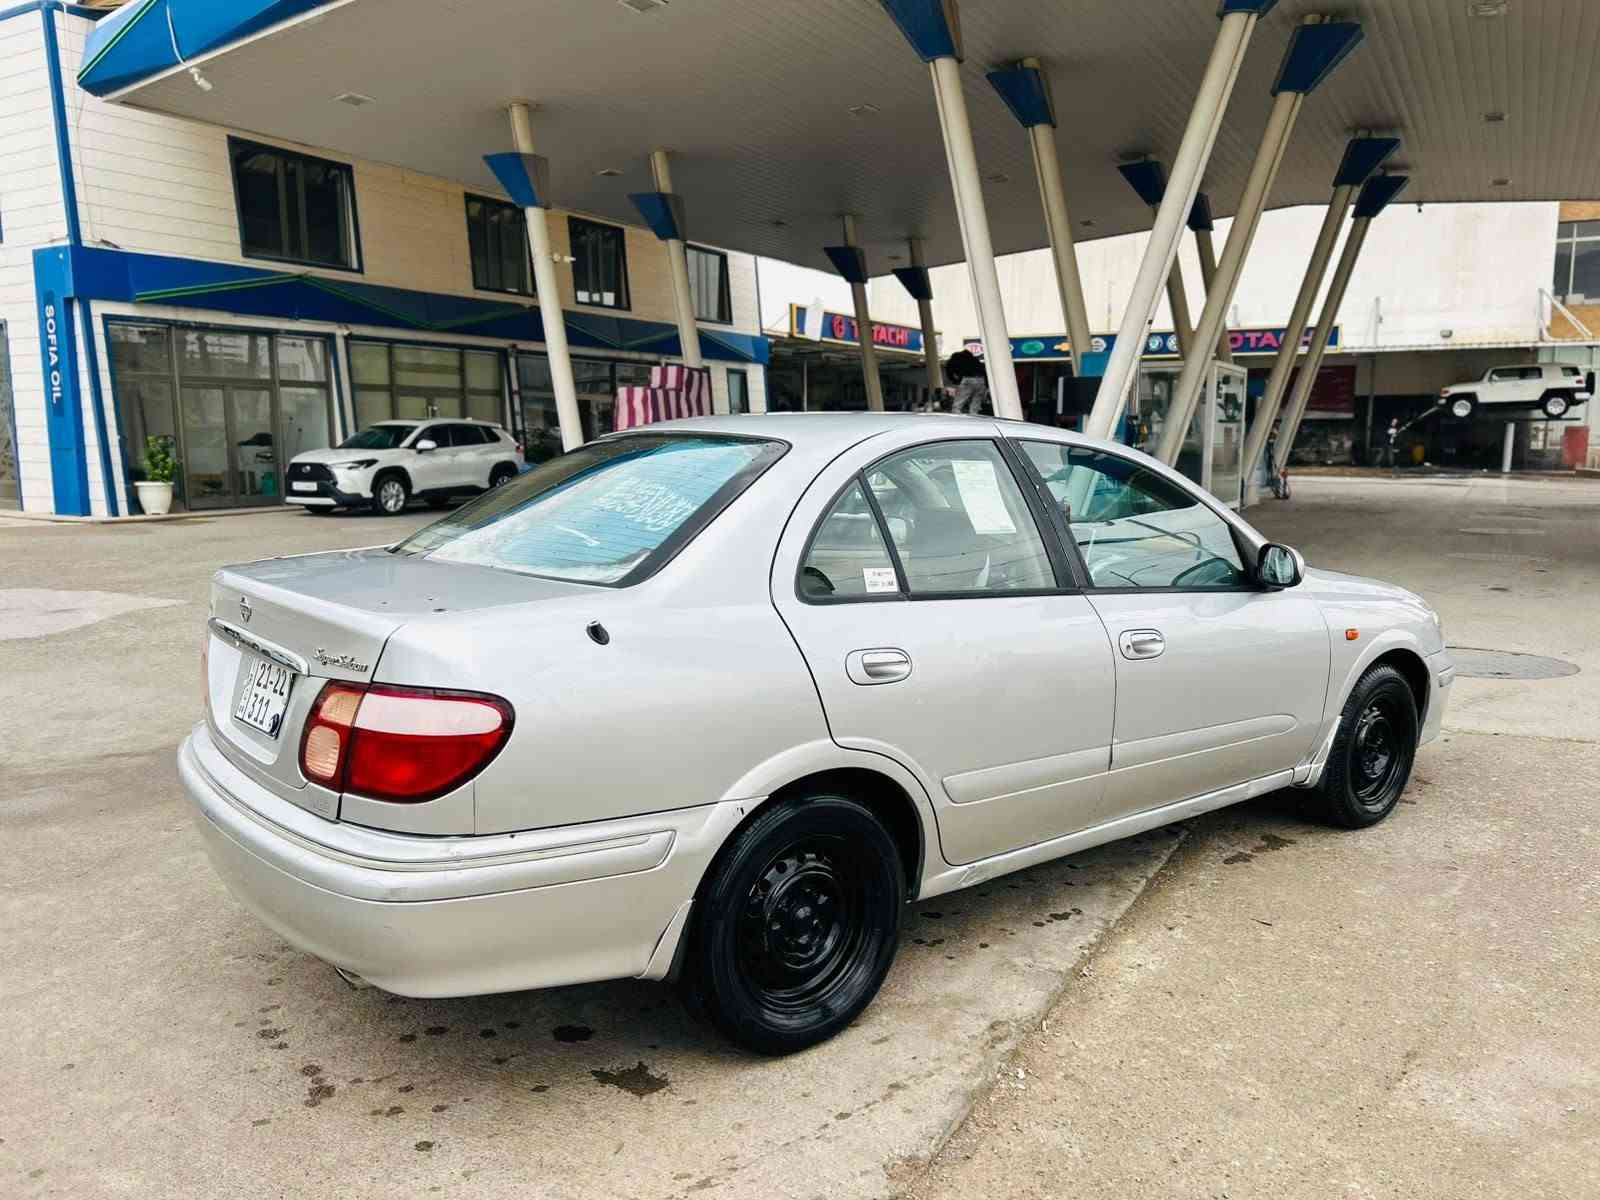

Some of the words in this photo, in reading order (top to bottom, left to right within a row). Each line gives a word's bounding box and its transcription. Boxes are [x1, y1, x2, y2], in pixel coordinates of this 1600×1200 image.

[45, 305, 58, 366] SOFIA
[851, 319, 909, 346] TTACHI
[50, 370, 62, 404] OIL
